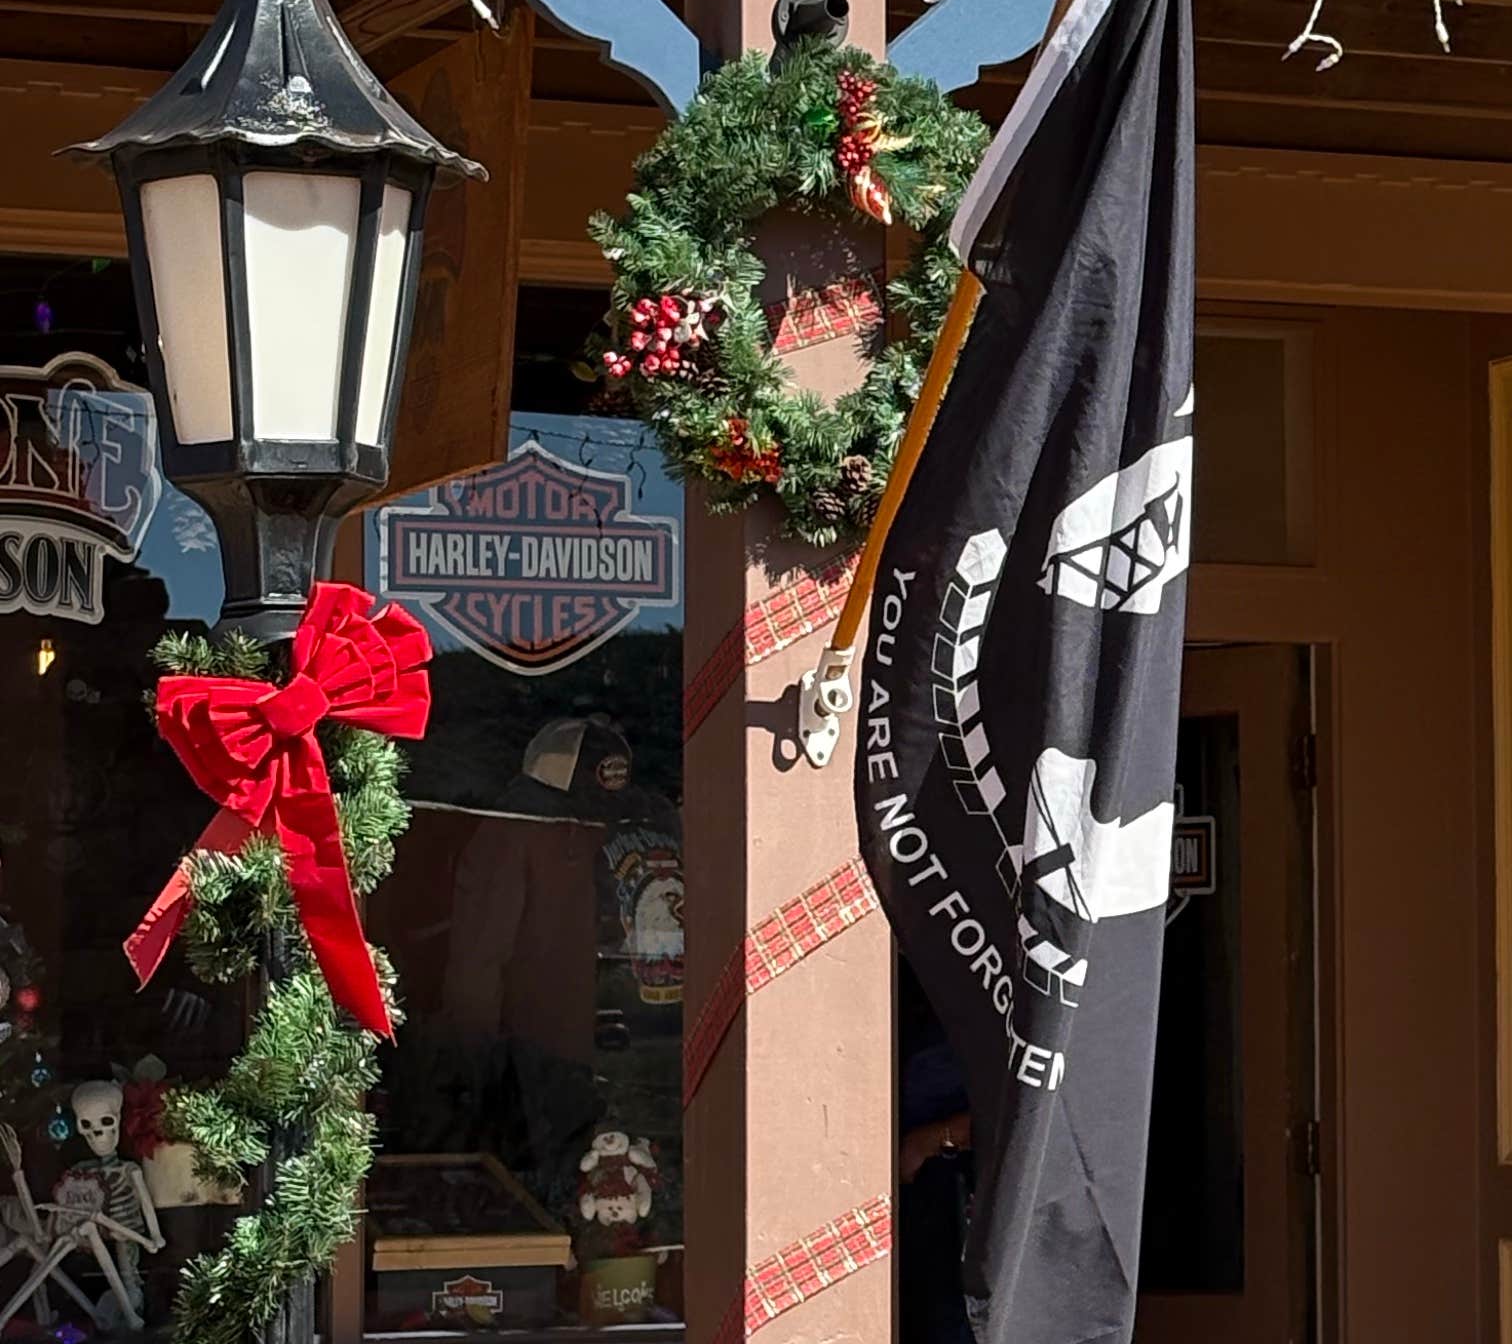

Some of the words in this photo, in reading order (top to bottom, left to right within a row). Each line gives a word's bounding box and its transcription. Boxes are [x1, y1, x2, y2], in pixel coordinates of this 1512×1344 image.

[467, 470, 600, 522] MOTOR
[408, 531, 653, 582] HARLEY-DAVIDSON
[466, 592, 596, 650] CYCLES
[876, 567, 916, 666] YOU
[867, 679, 898, 783] ARE
[874, 793, 949, 888] NOT
